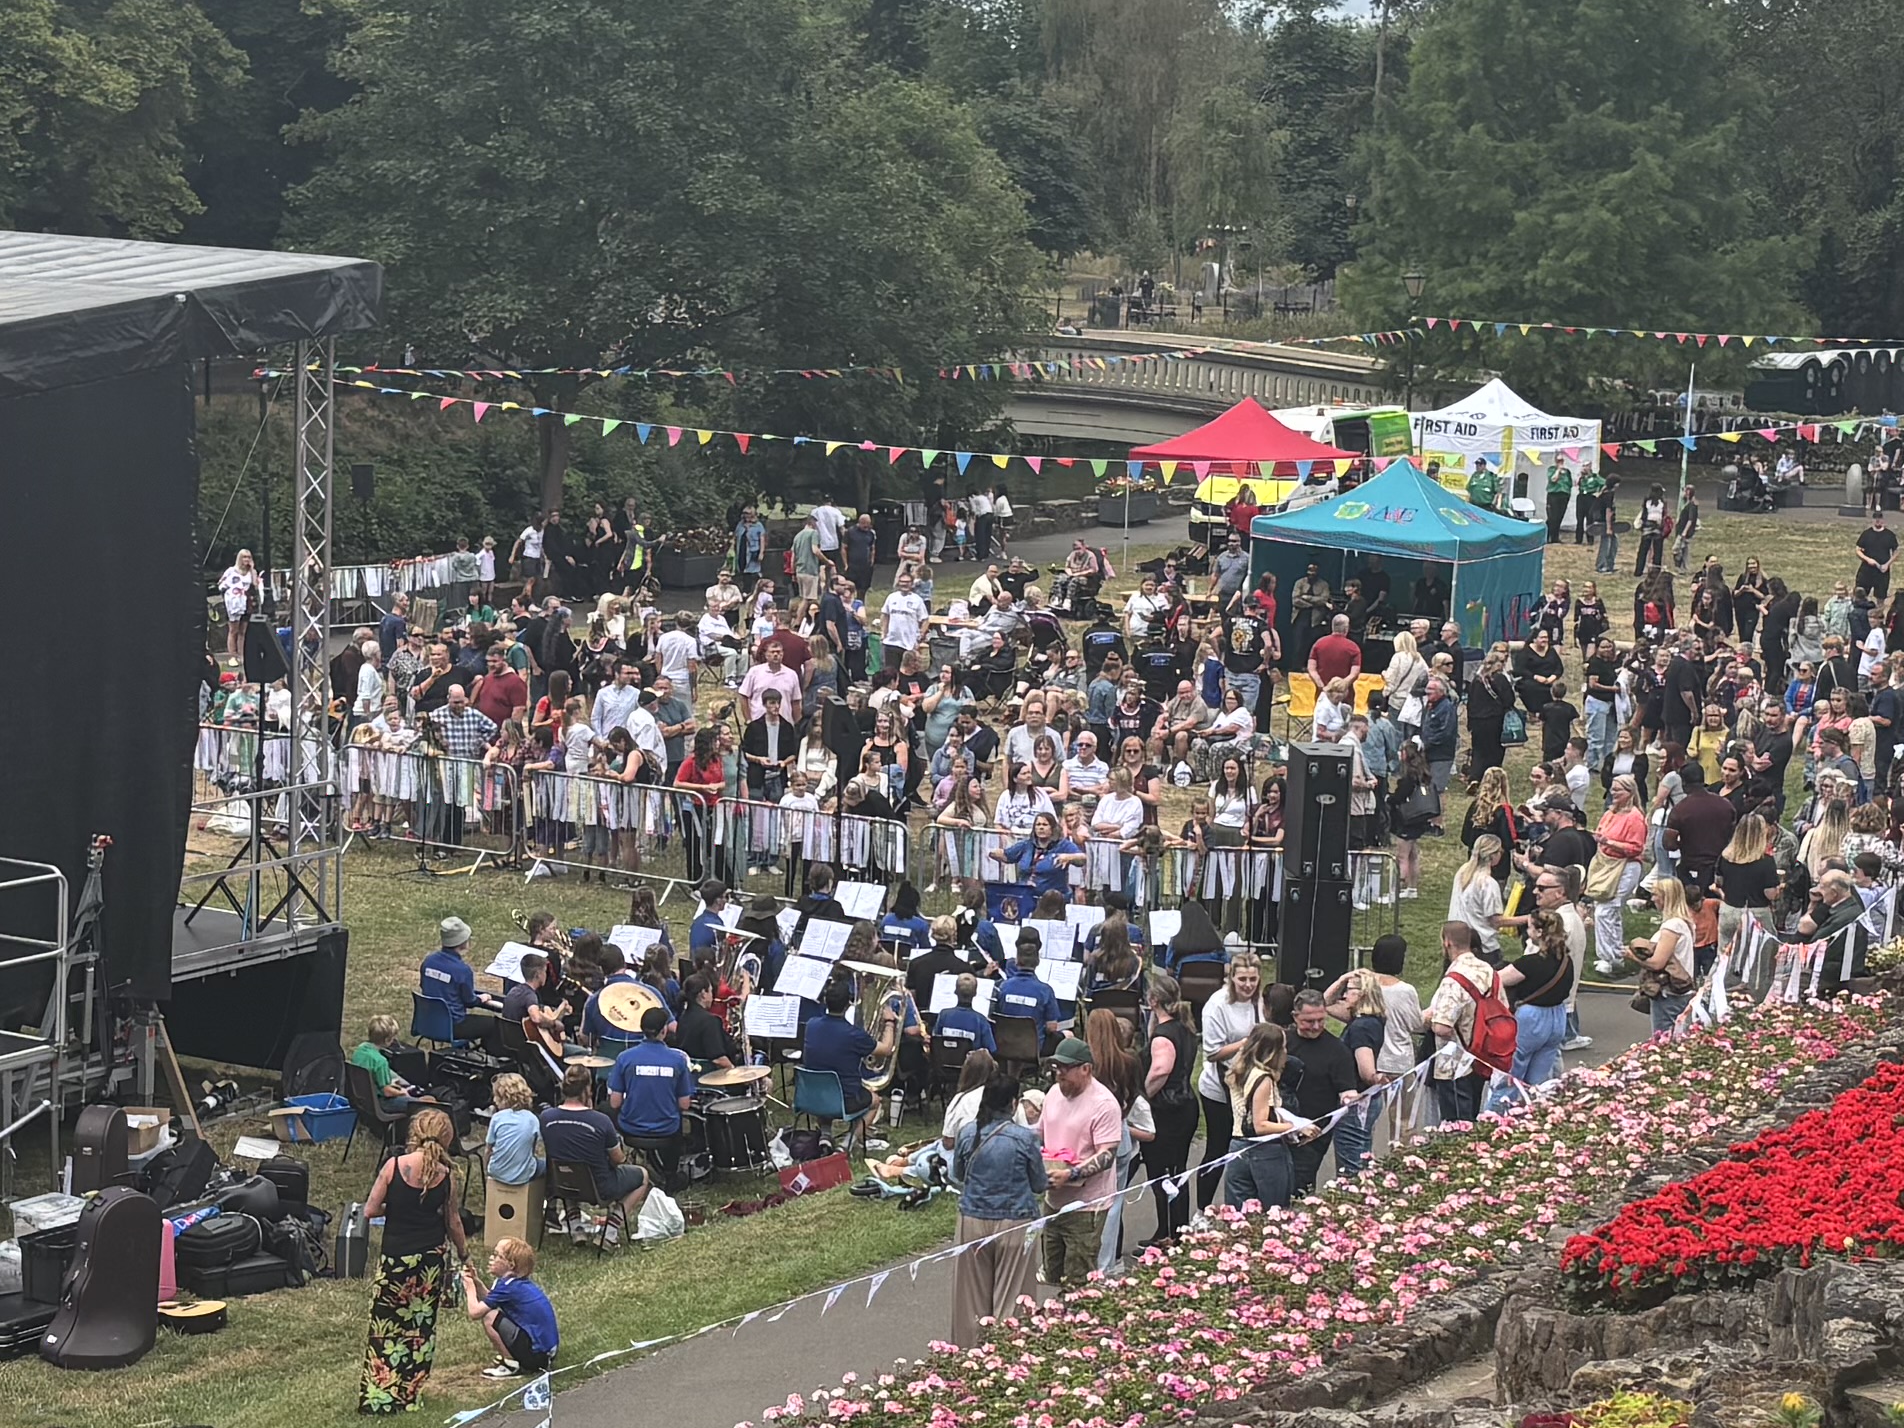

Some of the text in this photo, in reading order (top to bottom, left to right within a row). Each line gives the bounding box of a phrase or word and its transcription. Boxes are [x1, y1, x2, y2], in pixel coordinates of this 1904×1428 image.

[1414, 418, 1478, 437] FRST AID
[1530, 427, 1560, 440] FIRST
